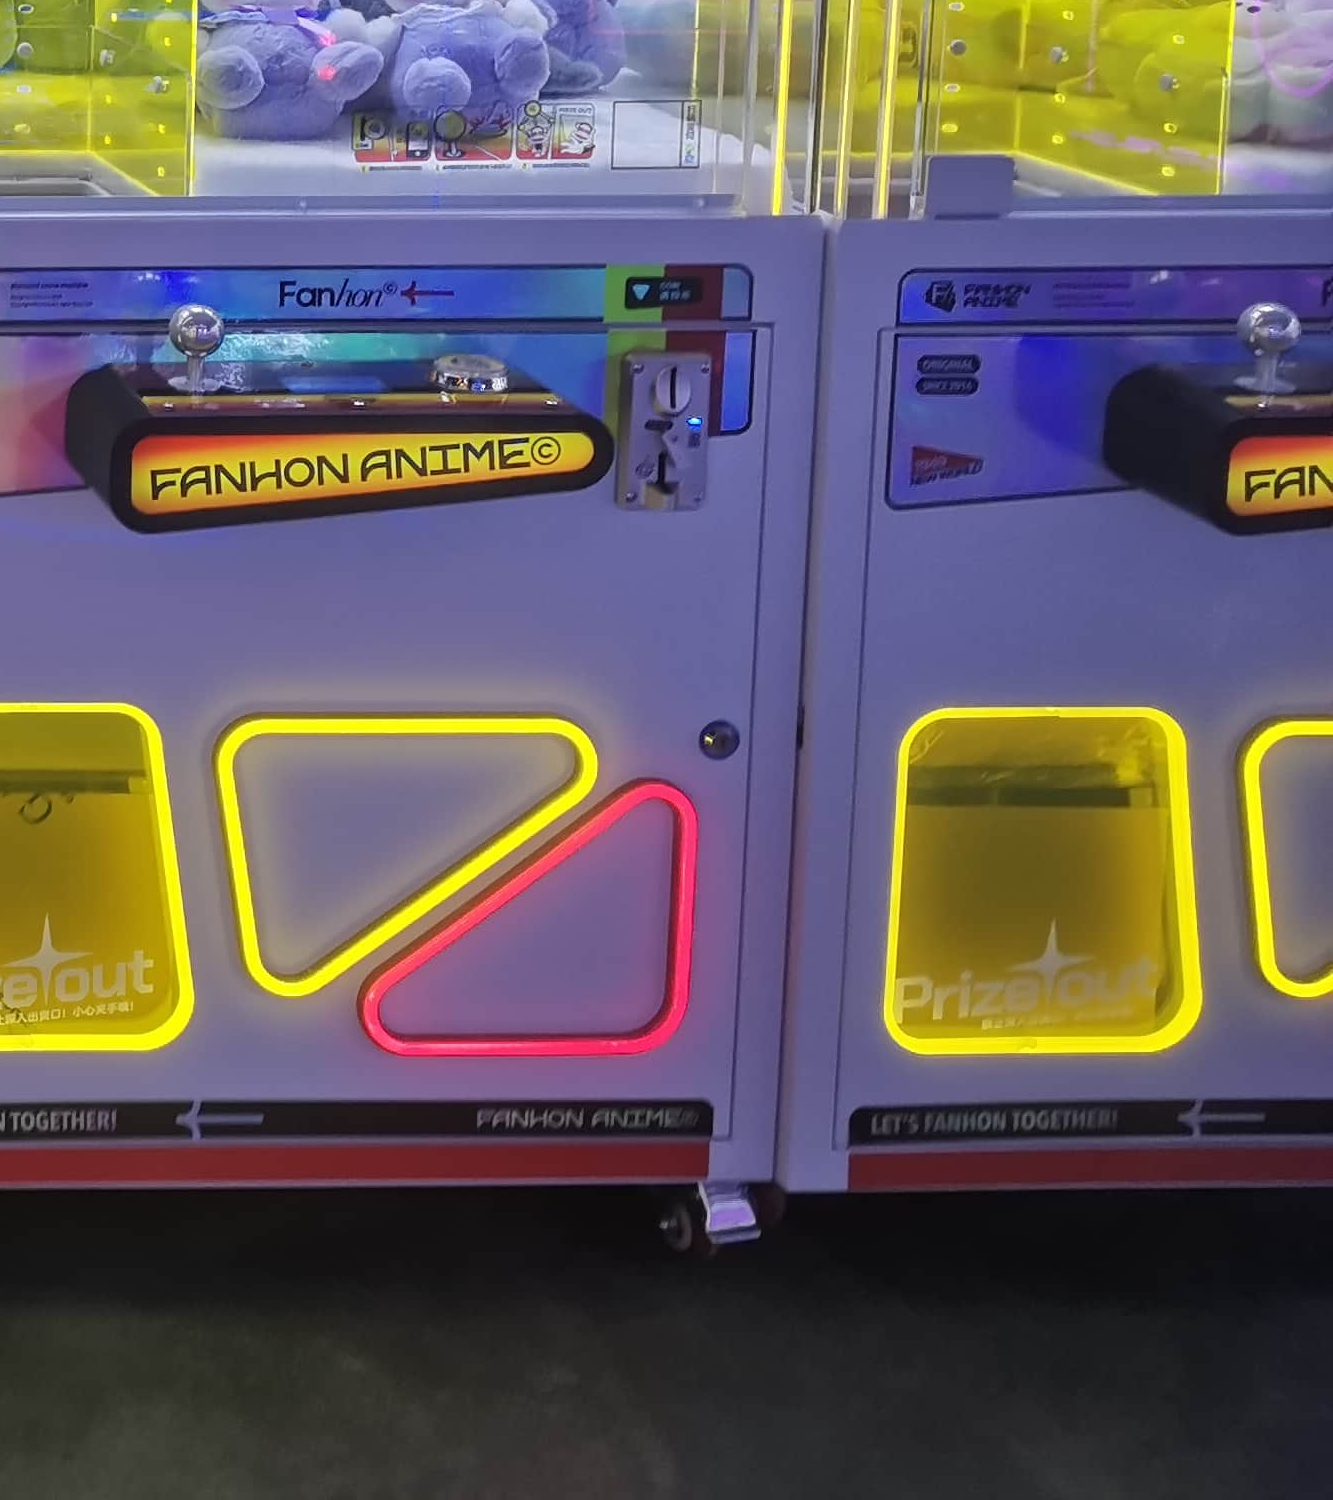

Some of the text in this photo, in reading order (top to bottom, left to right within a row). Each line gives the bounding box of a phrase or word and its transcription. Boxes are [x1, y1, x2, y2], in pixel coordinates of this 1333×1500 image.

[150, 452, 349, 501] FANHON
[54, 949, 154, 1003] out
[894, 968, 1041, 1024] Prize
[10, 1110, 118, 1133] TOGETHER!
